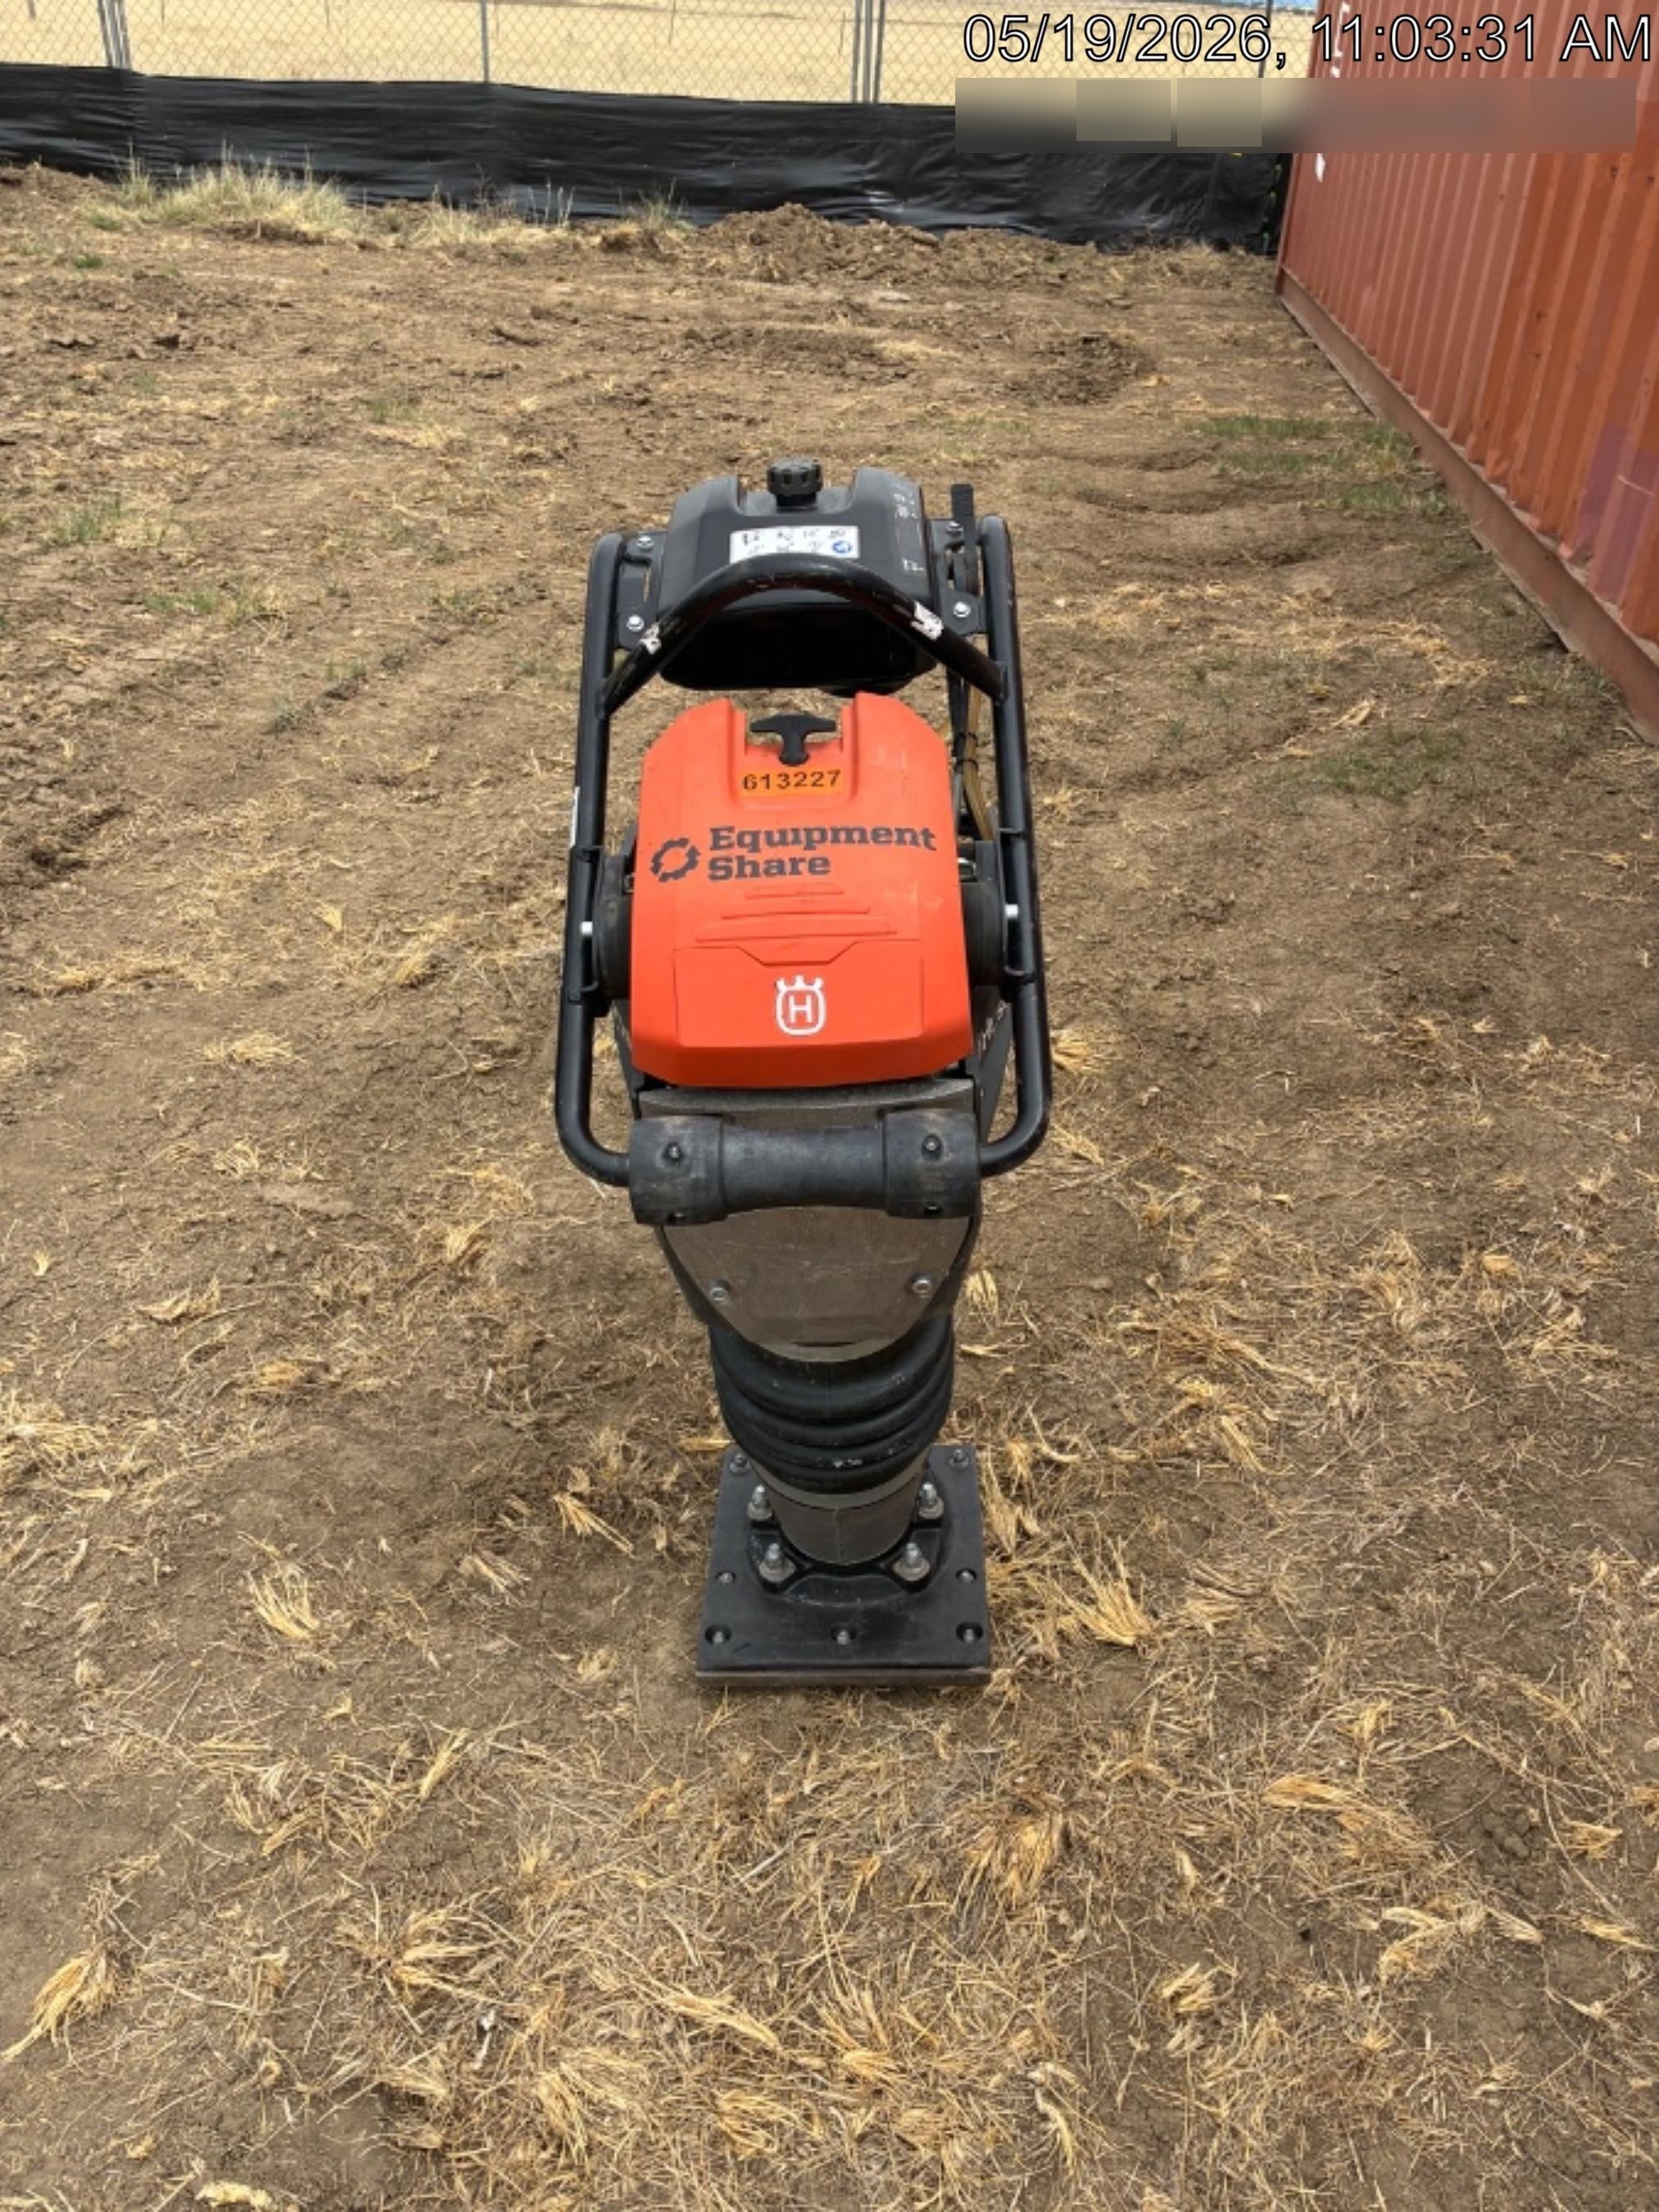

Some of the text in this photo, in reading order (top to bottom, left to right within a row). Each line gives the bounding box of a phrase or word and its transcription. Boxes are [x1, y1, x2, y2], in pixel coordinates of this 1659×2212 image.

[742, 768, 842, 791] 613227
[709, 825, 936, 853] Equipment
[707, 854, 832, 882] Share
